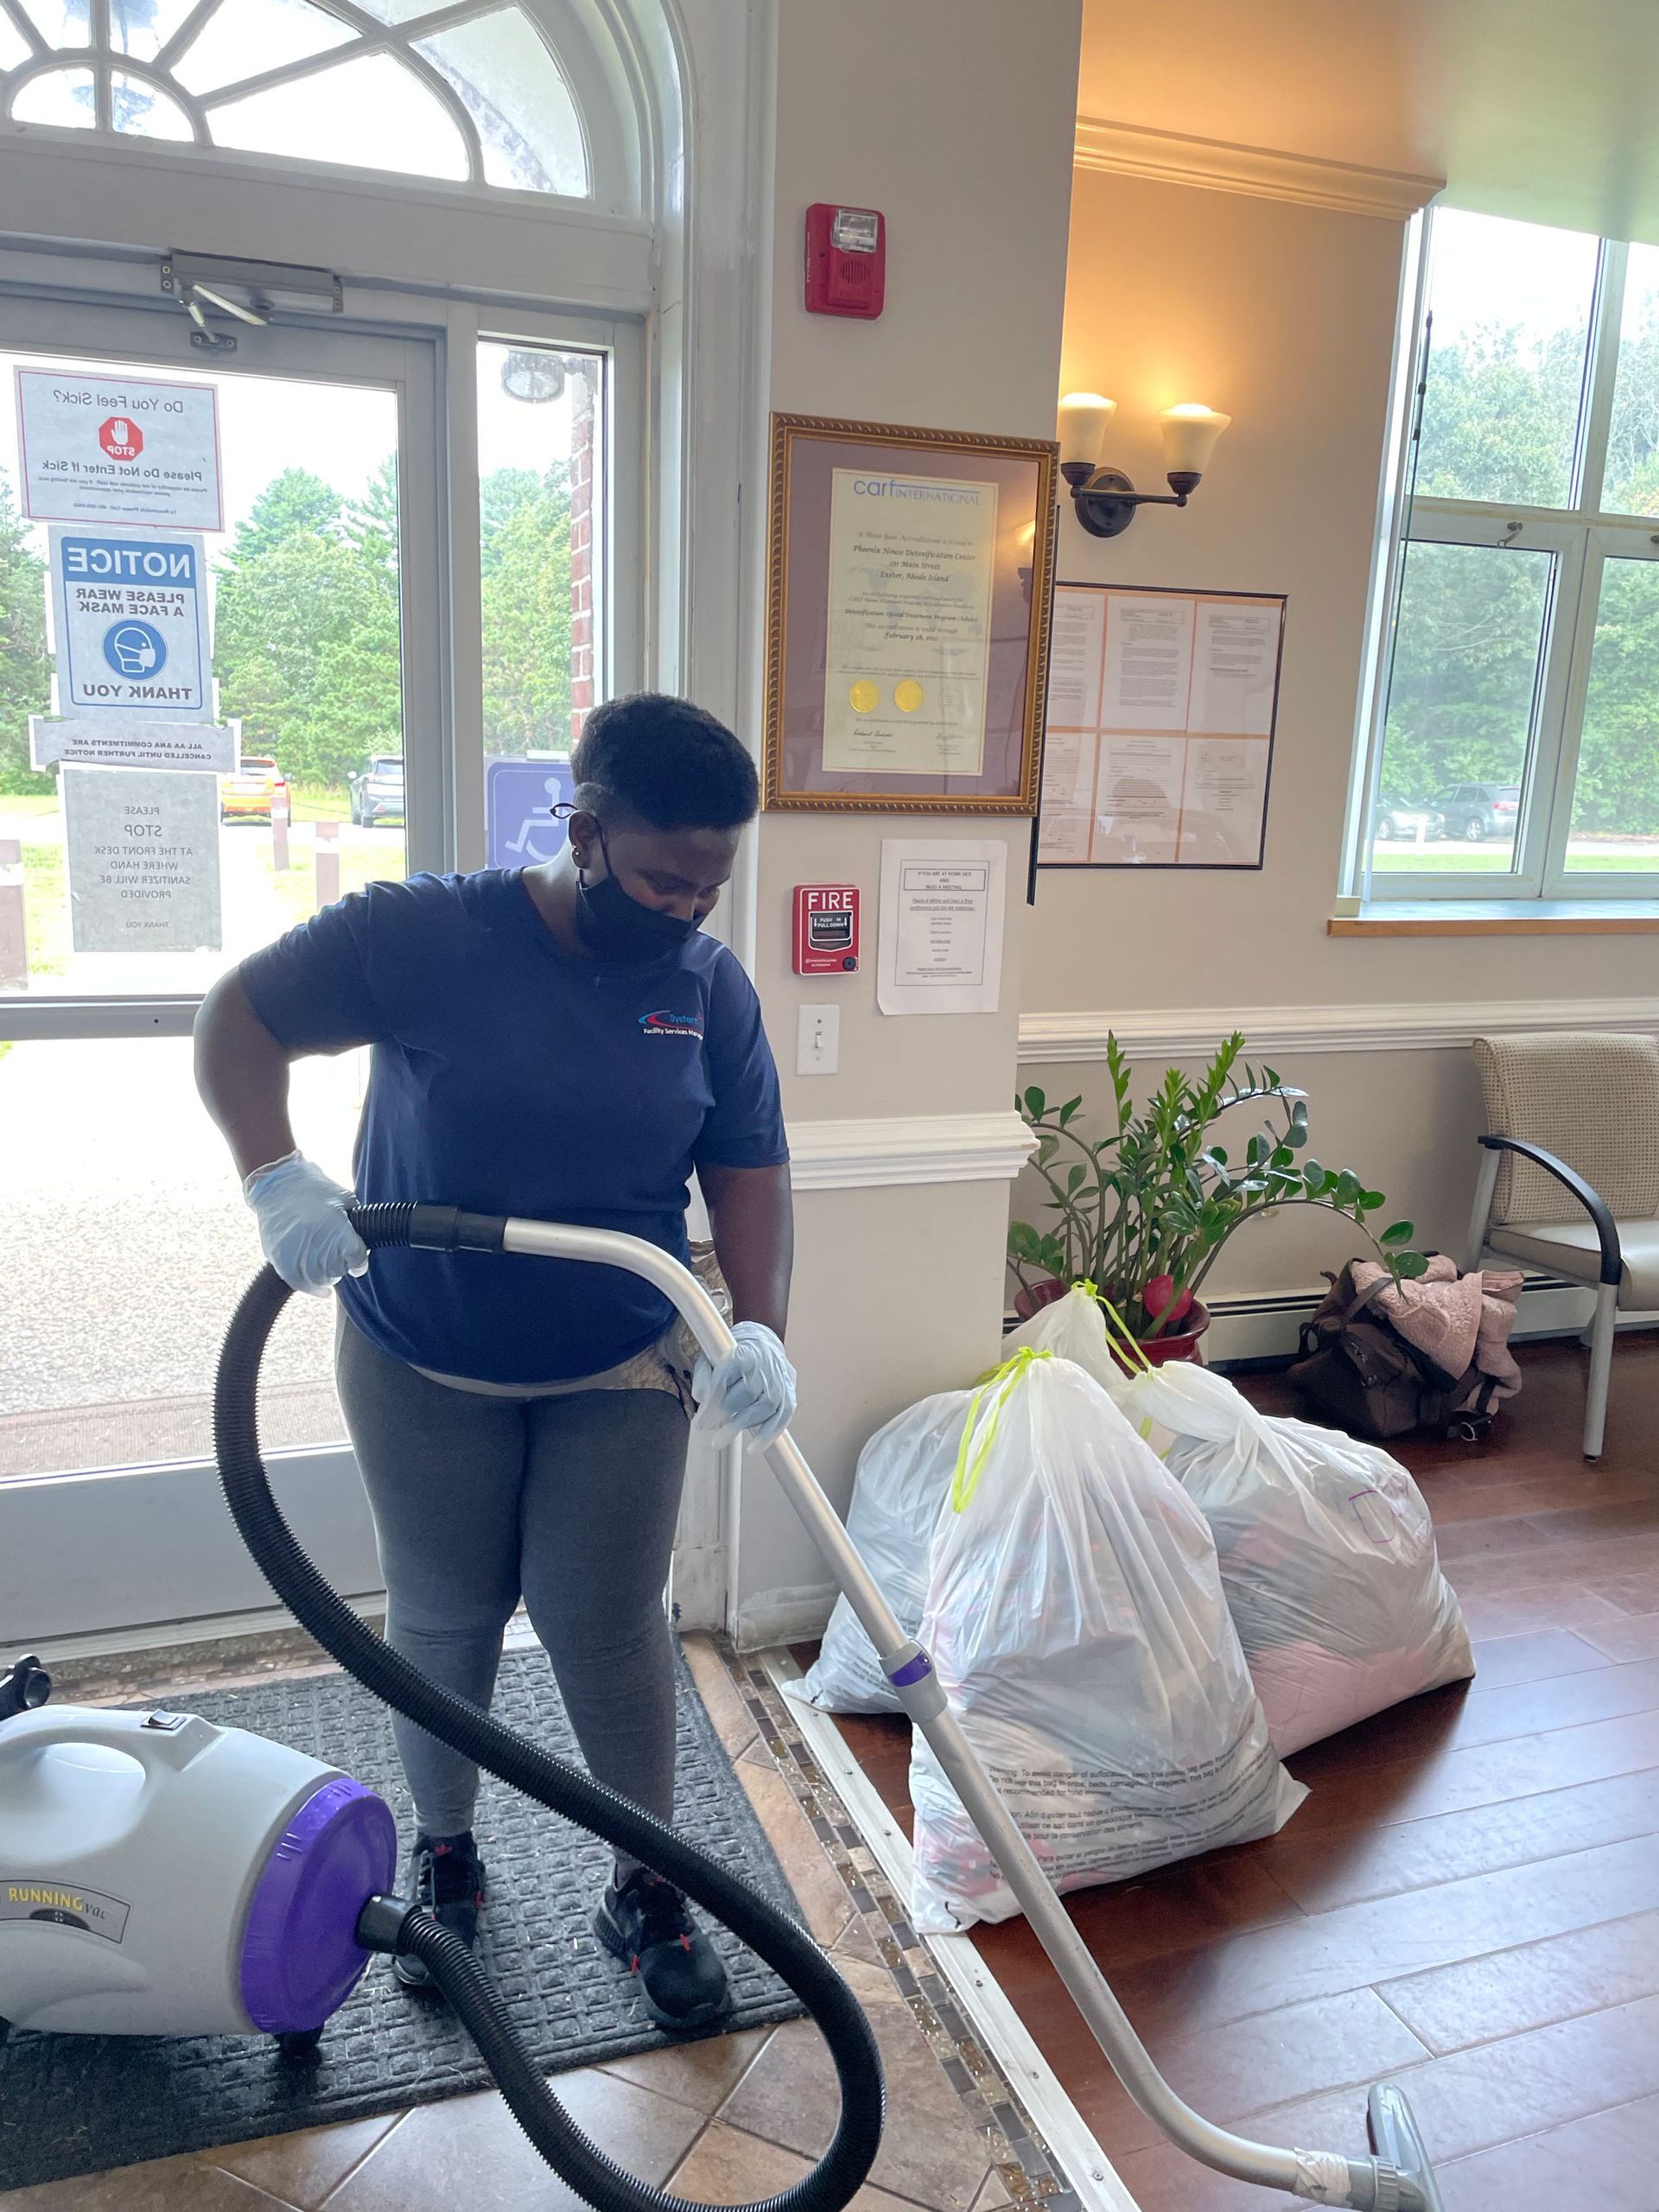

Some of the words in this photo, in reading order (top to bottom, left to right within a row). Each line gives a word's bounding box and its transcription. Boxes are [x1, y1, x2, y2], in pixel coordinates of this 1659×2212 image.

[853, 479, 895, 498] carf
[896, 488, 980, 505] INTERNATIONAL
[853, 544, 880, 554] Phoenix
[906, 549, 954, 560] Detoxification
[884, 632, 914, 641] February
[808, 892, 854, 910] FIRE
[1044, 1780, 1058, 1789] bag
[9, 1887, 84, 1912] RUNNING
